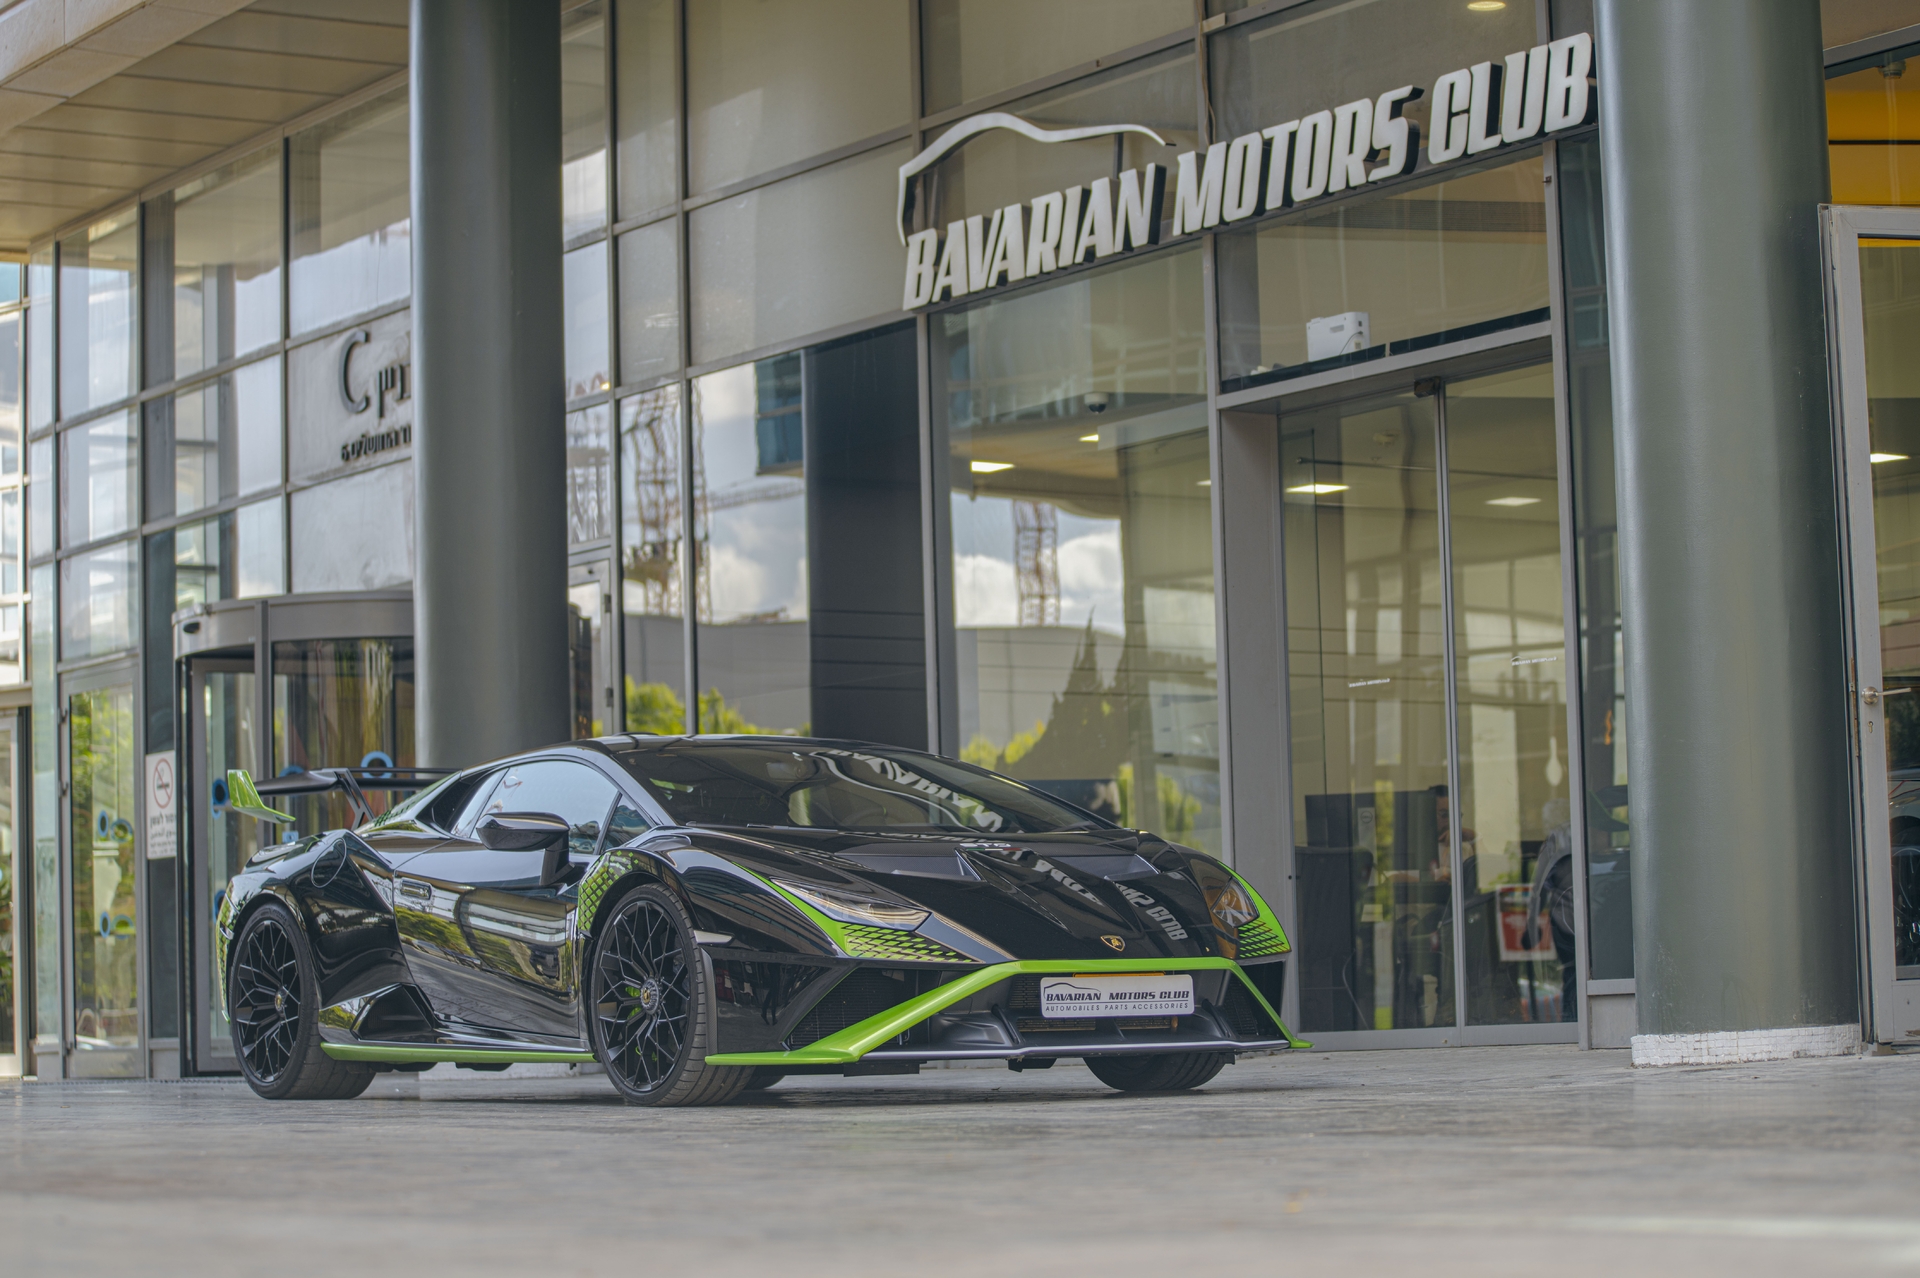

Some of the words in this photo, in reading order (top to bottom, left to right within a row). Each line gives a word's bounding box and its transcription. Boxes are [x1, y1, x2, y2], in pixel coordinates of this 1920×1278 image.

[902, 163, 1165, 310] BAVARIAN
[1172, 85, 1424, 237] MOTORS
[1428, 32, 1598, 165] CLUB
[339, 330, 370, 414] C
[1046, 992, 1102, 1002] BAVARIAN
[1108, 991, 1156, 1001] MOTORS
[1159, 990, 1190, 1000] CLUB
